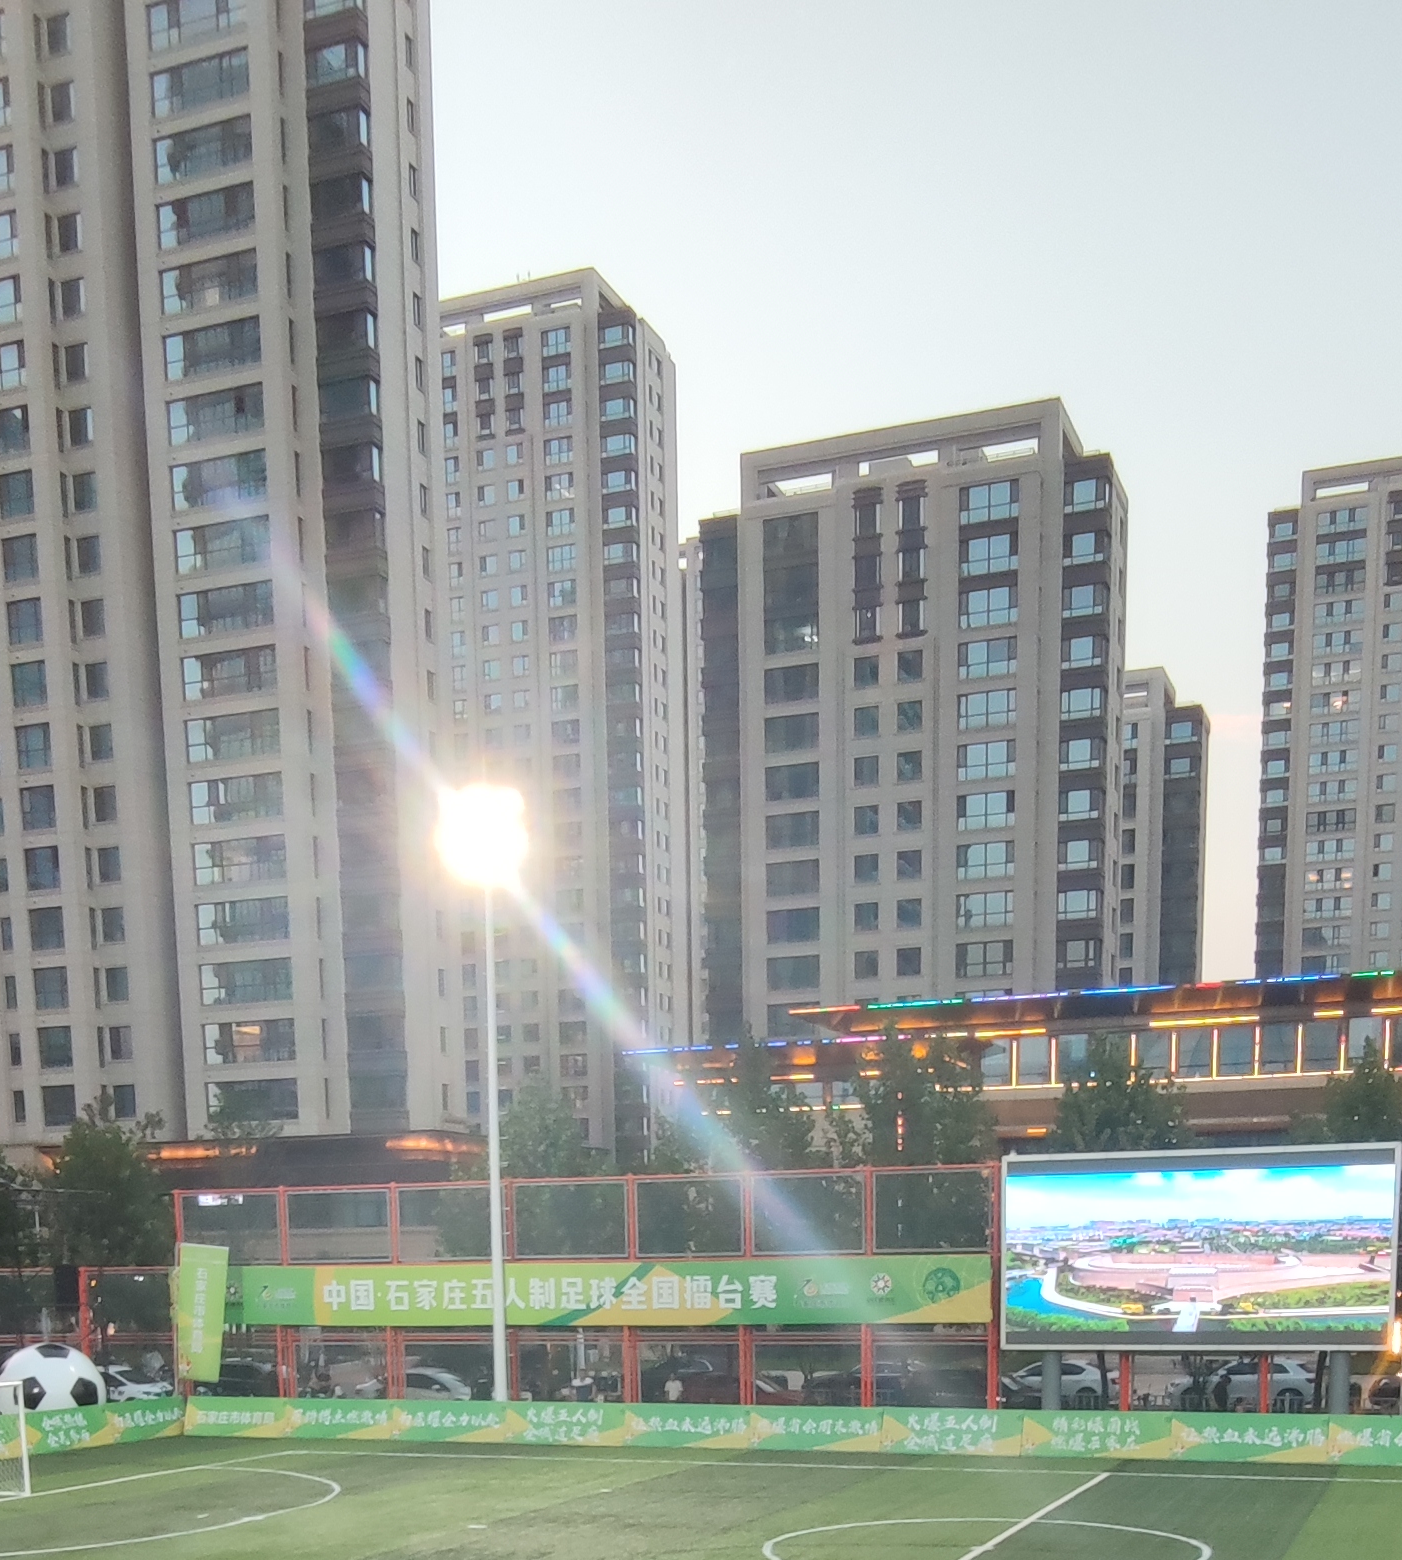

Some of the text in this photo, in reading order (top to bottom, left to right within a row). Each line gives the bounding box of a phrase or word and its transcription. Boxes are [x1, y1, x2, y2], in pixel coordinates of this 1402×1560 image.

[322, 1273, 778, 1313] 中国·石家庄五人制足球全国擂台赛
